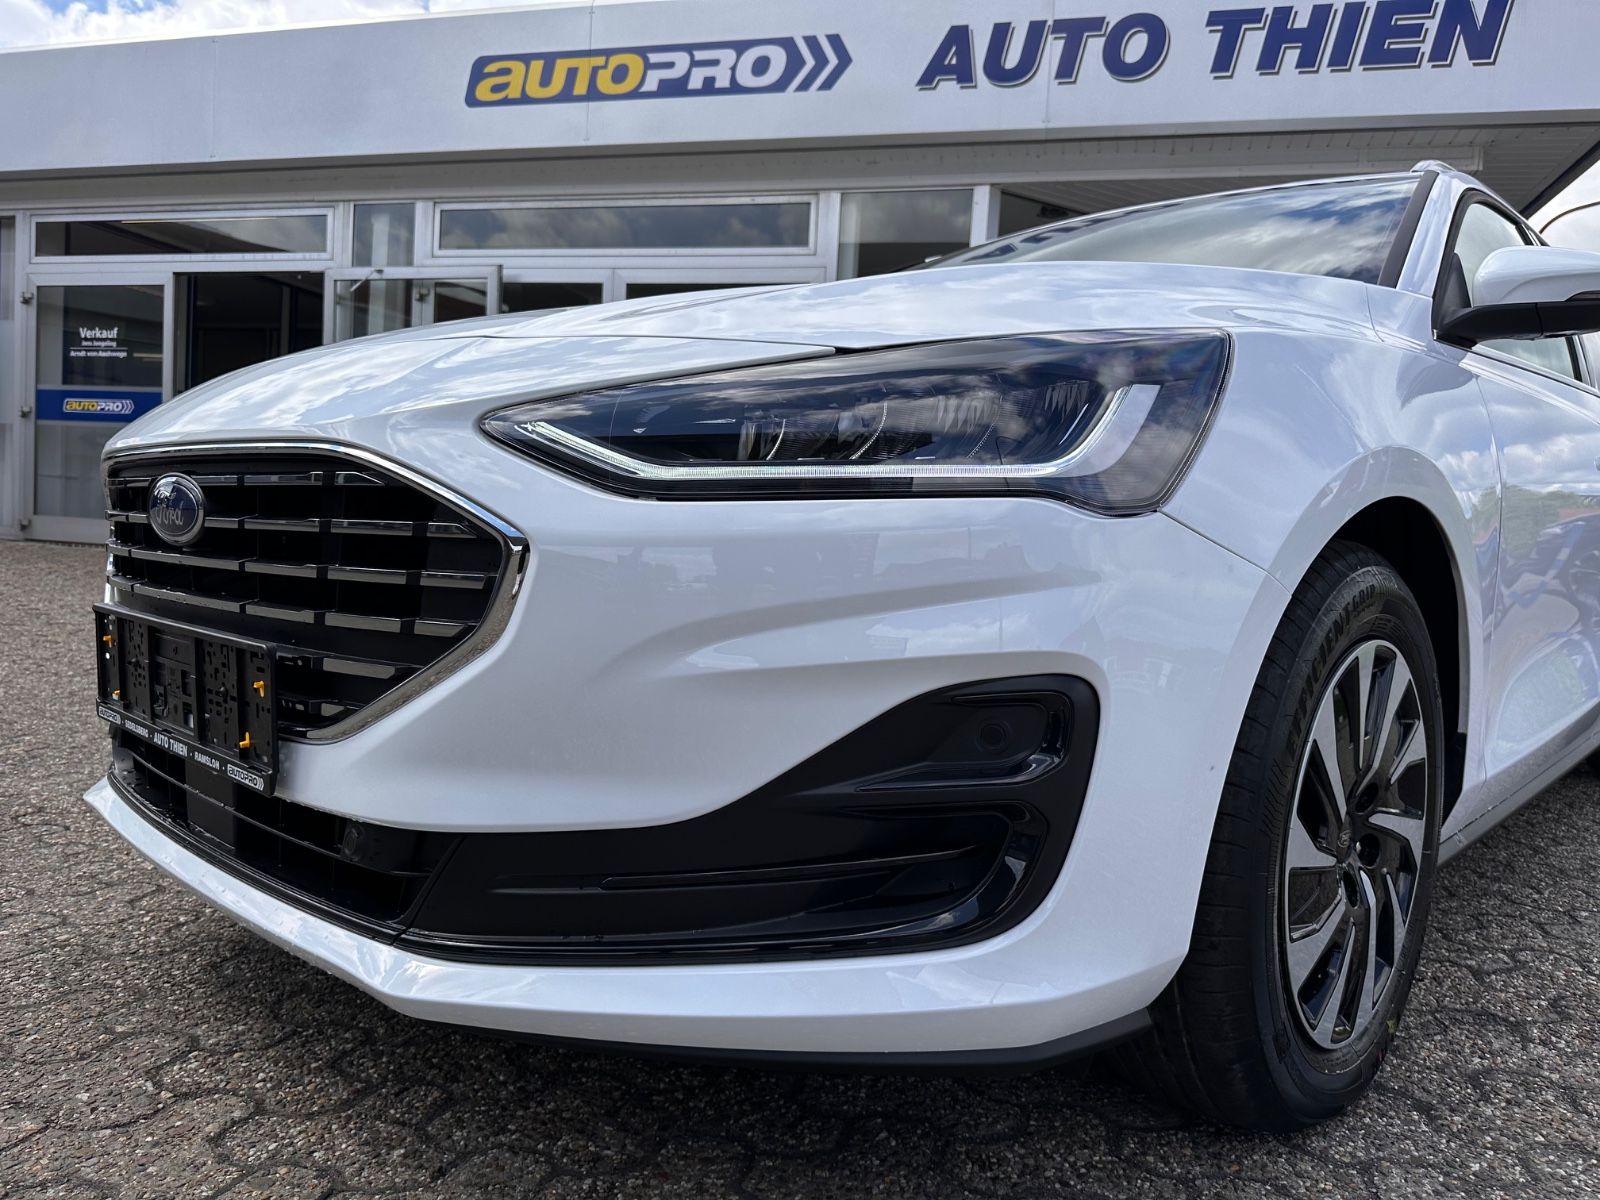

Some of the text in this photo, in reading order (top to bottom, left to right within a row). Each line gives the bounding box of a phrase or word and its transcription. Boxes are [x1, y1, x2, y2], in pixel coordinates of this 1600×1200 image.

[916, 0, 1515, 91] AUTO THIEN
[79, 326, 118, 339] Verkauf
[154, 500, 184, 526] Ford
[153, 731, 169, 749] AUTO
[170, 738, 188, 757] THIEN
